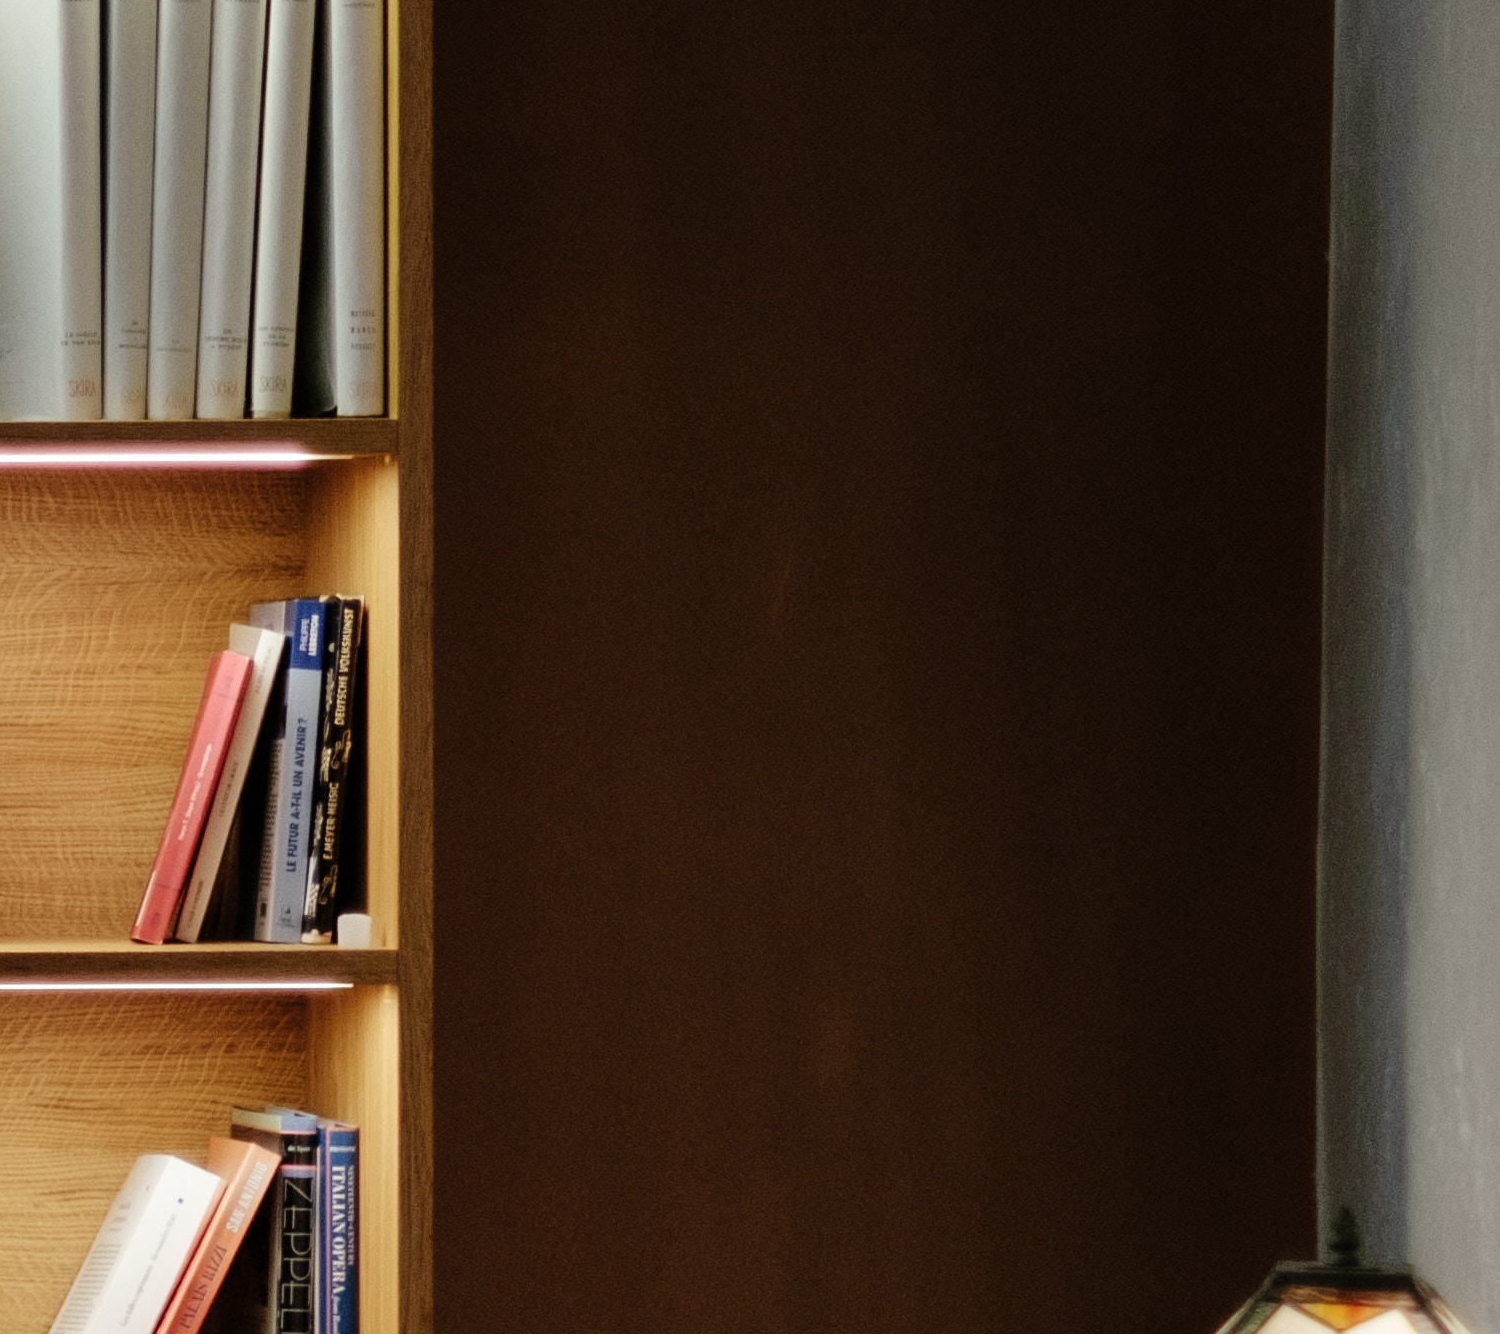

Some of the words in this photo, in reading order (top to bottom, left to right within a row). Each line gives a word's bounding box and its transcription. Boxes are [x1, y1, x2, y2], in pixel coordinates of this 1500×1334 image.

[295, 726, 307, 768] AVENIR
[293, 770, 304, 787] UN
[288, 822, 301, 857] FUTUR
[286, 857, 298, 873] LE
